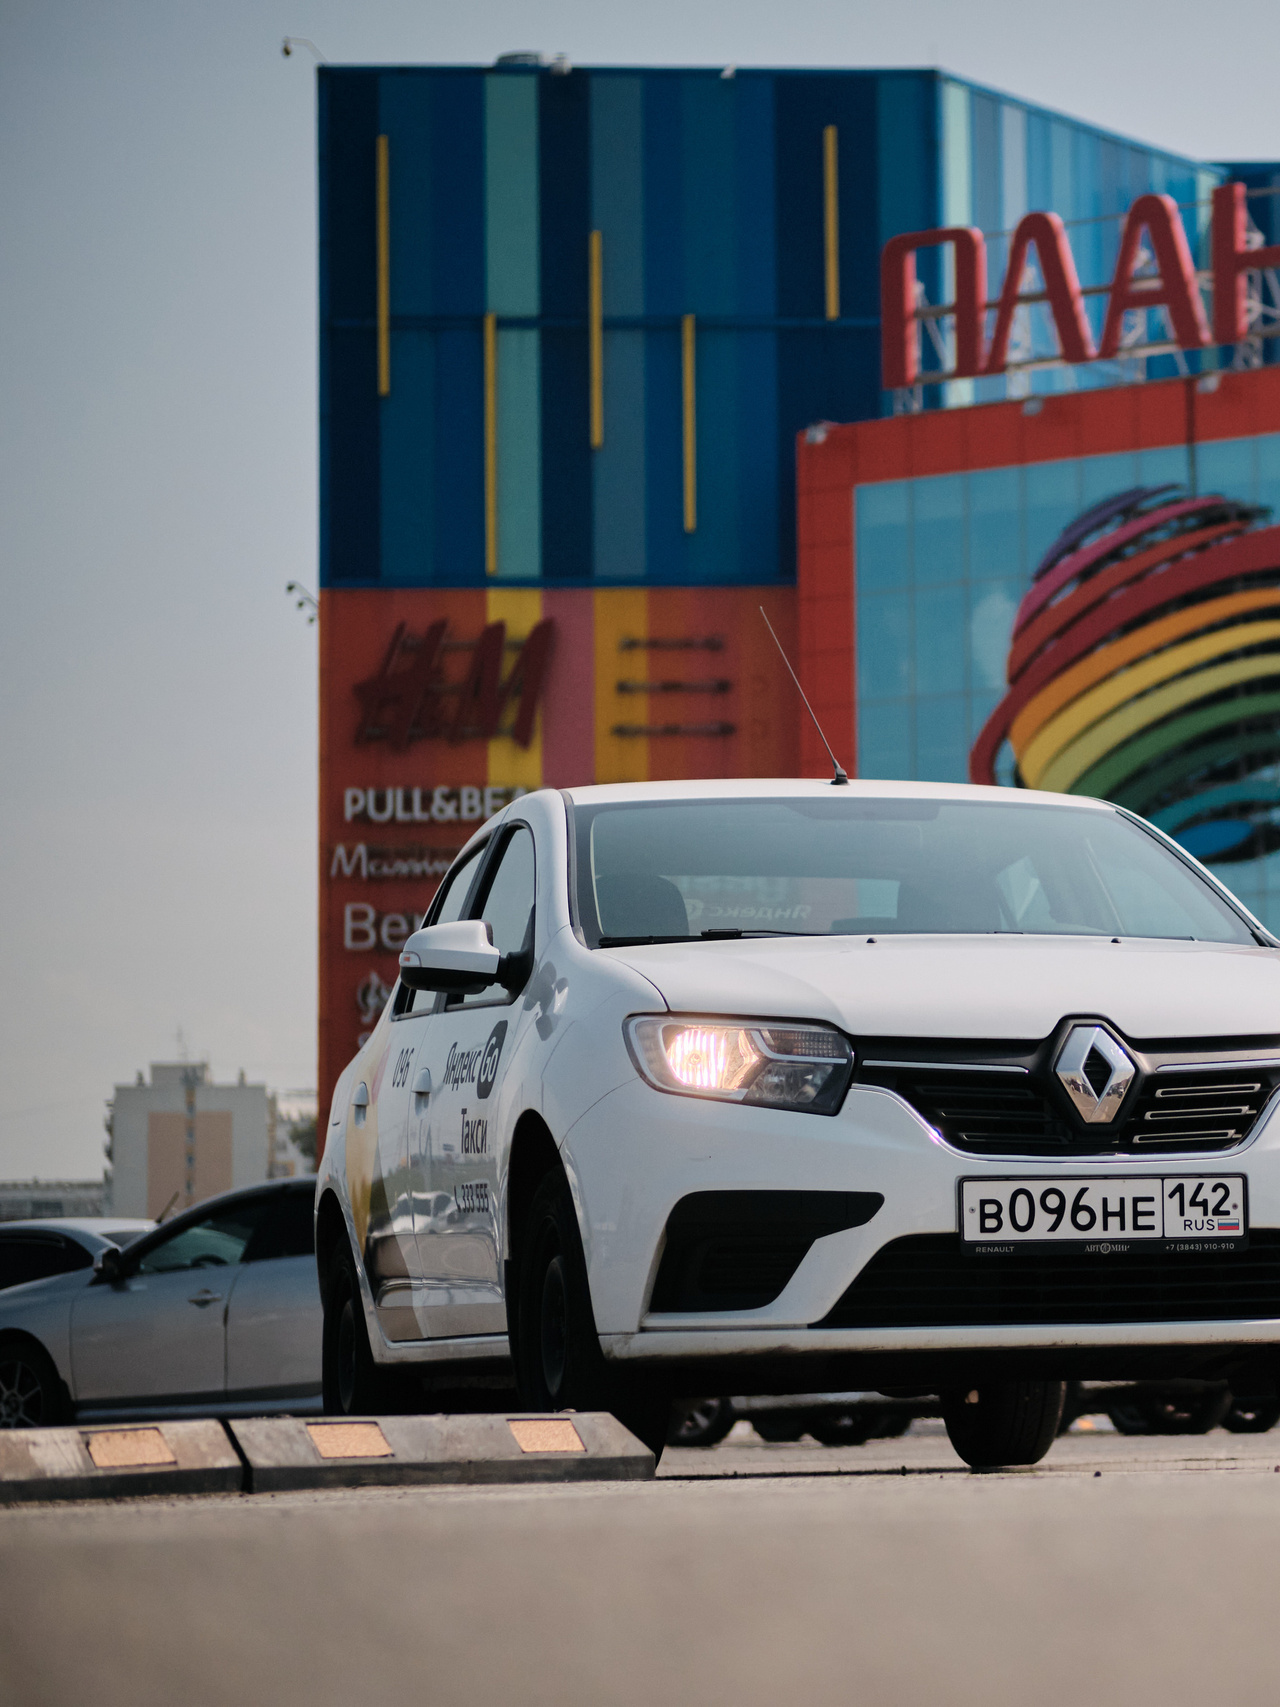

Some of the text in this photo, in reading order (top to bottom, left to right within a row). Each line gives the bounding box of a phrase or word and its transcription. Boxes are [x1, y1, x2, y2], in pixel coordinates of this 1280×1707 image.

[392, 1048, 415, 1088] 096
[443, 1036, 500, 1091] Яндекс Go
[461, 1108, 488, 1154] Такси
[461, 1183, 490, 1213] 333 555
[979, 1182, 1231, 1234] В096НЕ 142
[1183, 1219, 1216, 1231] RUS
[1176, 1243, 1202, 1251] (3843)
[1204, 1242, 1235, 1251] 910-910
